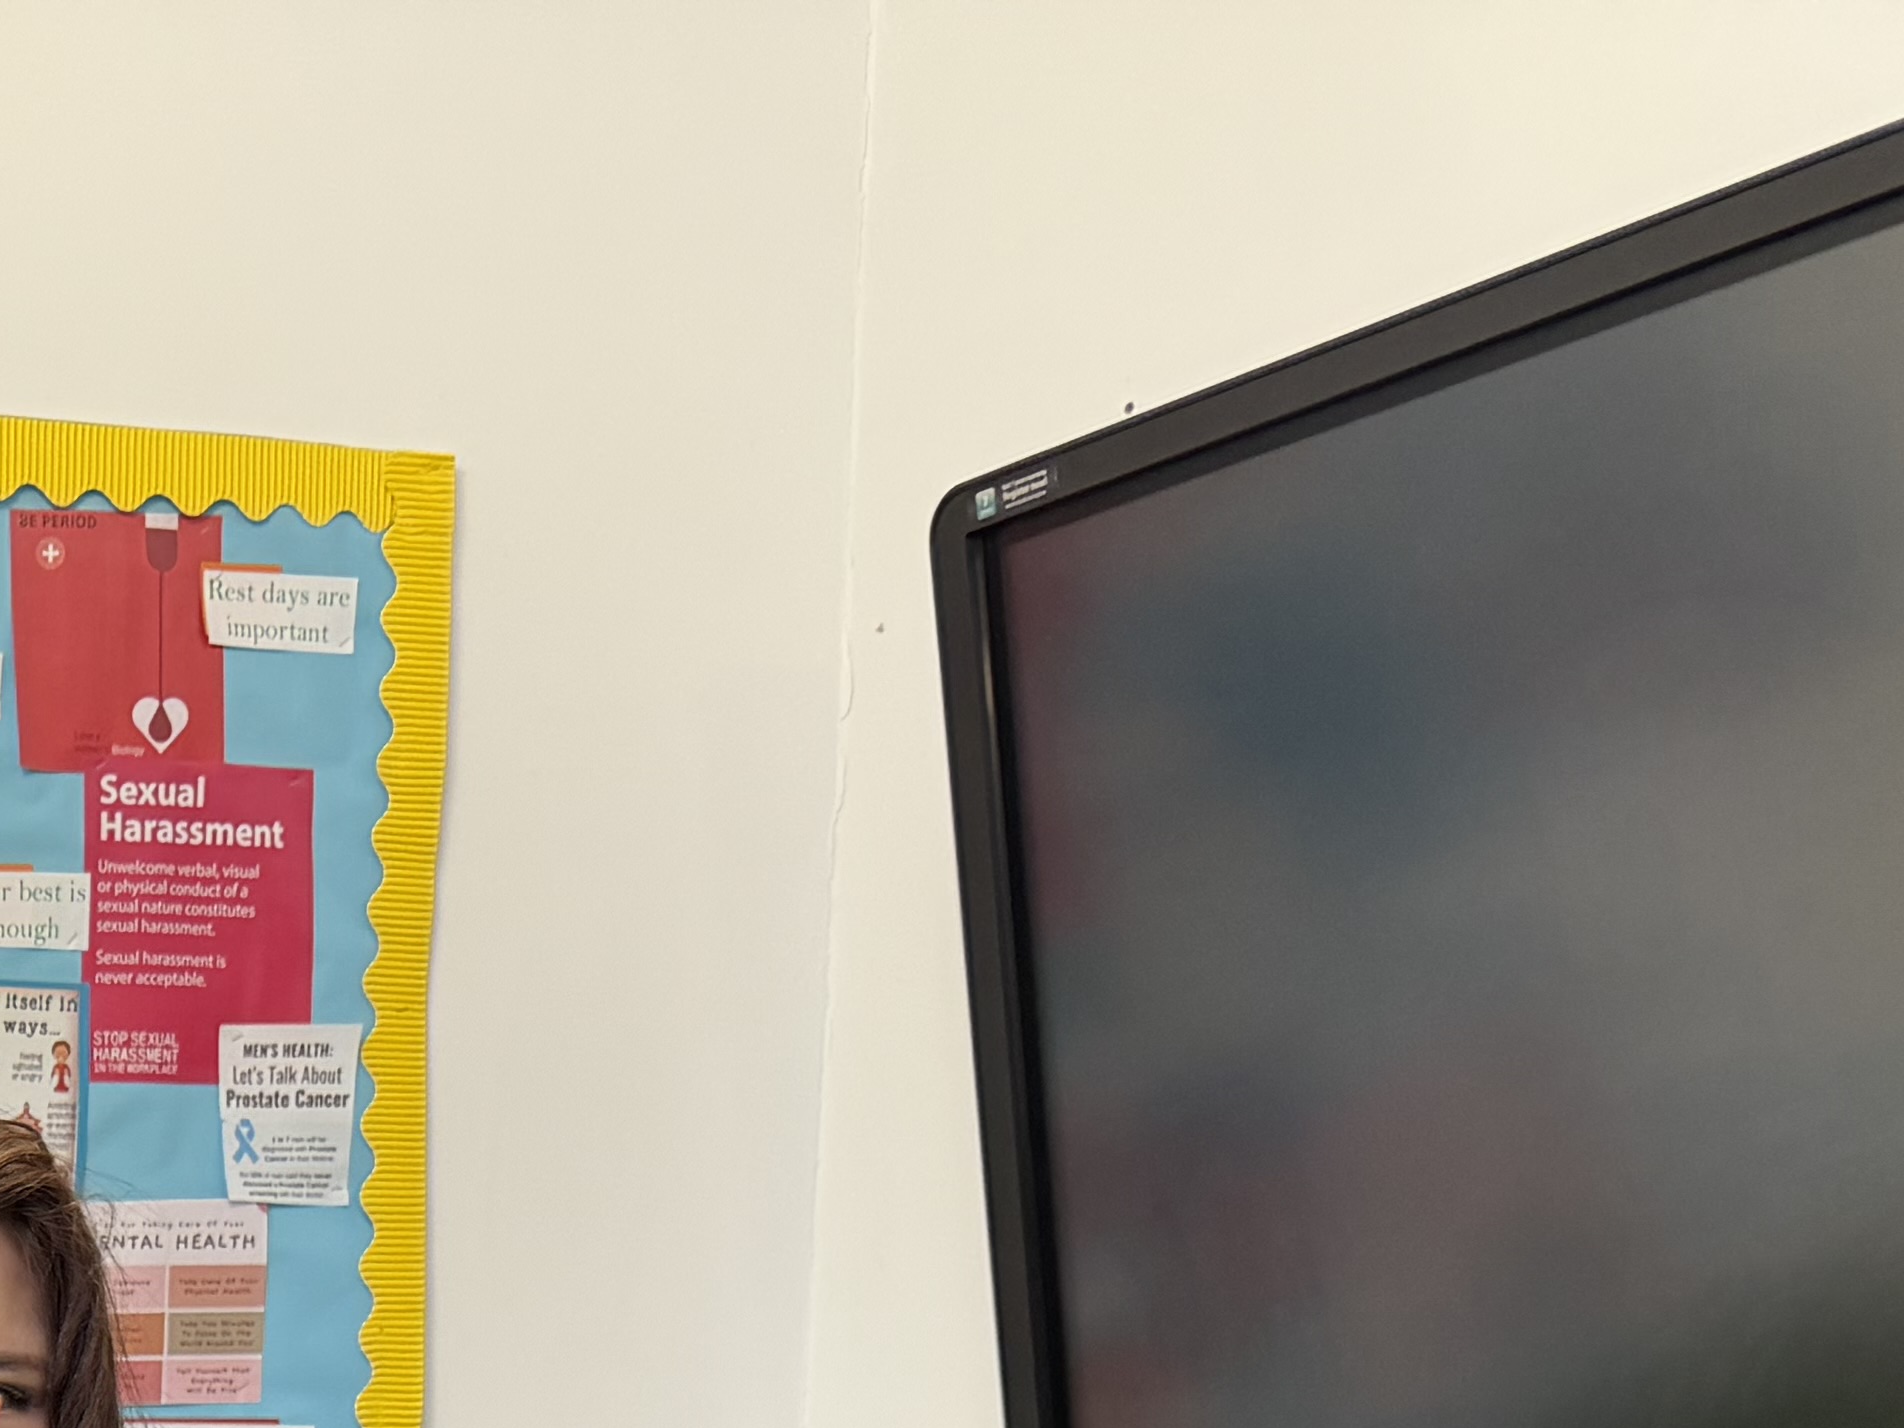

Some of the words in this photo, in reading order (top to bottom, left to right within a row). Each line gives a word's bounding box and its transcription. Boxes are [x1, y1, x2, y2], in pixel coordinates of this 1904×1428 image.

[42, 514, 97, 529] PERIOD
[208, 577, 254, 603] Rest
[262, 581, 309, 612] days
[317, 588, 350, 608] are
[225, 615, 329, 645] important
[100, 774, 206, 808] Sexual
[100, 811, 284, 849] Harassment
[97, 859, 175, 876] Unwelcome
[177, 862, 219, 880] verbal,
[222, 864, 260, 879] visual
[19, 880, 62, 902] best
[70, 883, 86, 903] is
[97, 879, 112, 893] or
[114, 880, 168, 897] physical
[169, 881, 221, 898] conduct
[224, 883, 239, 898] of
[240, 886, 248, 898] a
[97, 899, 139, 914] sexual
[142, 902, 183, 916] nature
[184, 904, 256, 918] constitutes
[97, 918, 139, 933] sexual
[141, 919, 216, 937] harassment.
[96, 949, 140, 965] Sexual
[142, 951, 213, 968] harassment
[216, 955, 226, 969] is
[95, 972, 133, 985] never
[135, 972, 207, 989] acceptable.
[4, 1019, 61, 1038] ways...
[93, 1030, 129, 1046] STOP
[131, 1031, 179, 1049] SEXUAL
[93, 1047, 179, 1063] HARASSMENT
[242, 1043, 279, 1059] MEN'S
[282, 1043, 333, 1059] HEALTH:
[232, 1066, 264, 1085] Let's
[269, 1065, 296, 1085] Talk
[301, 1066, 343, 1085] About
[226, 1090, 289, 1109] Prostate
[294, 1090, 350, 1109] Cancer
[100, 1234, 163, 1249] ENTAL
[176, 1234, 256, 1250] HEALTH
